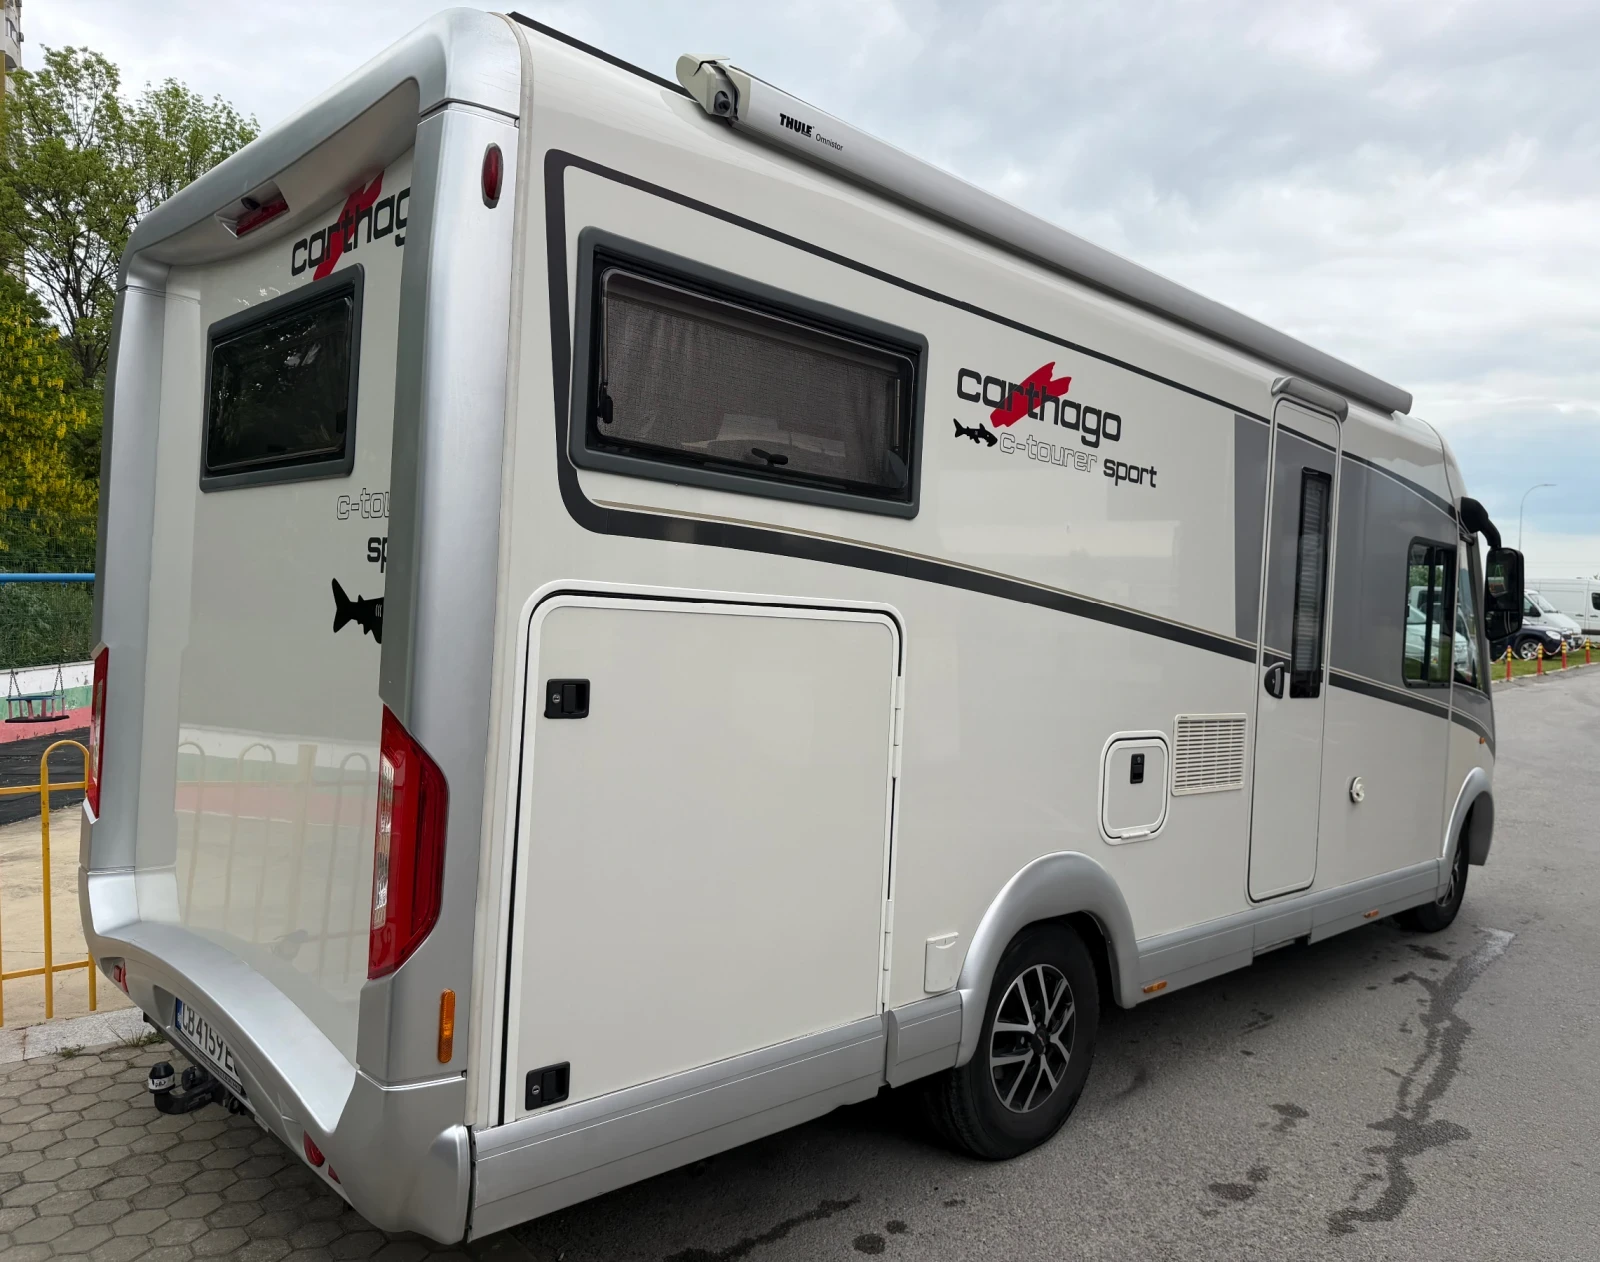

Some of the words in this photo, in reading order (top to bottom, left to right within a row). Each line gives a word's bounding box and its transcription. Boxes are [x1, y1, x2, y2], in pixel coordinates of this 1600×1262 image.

[779, 113, 812, 138] THULE
[815, 133, 844, 151] Omnistor
[291, 187, 411, 277] carthag
[957, 367, 1122, 449] carthago
[999, 432, 1098, 473] c-tourer
[1103, 458, 1158, 489] sport
[336, 488, 390, 520] c-to
